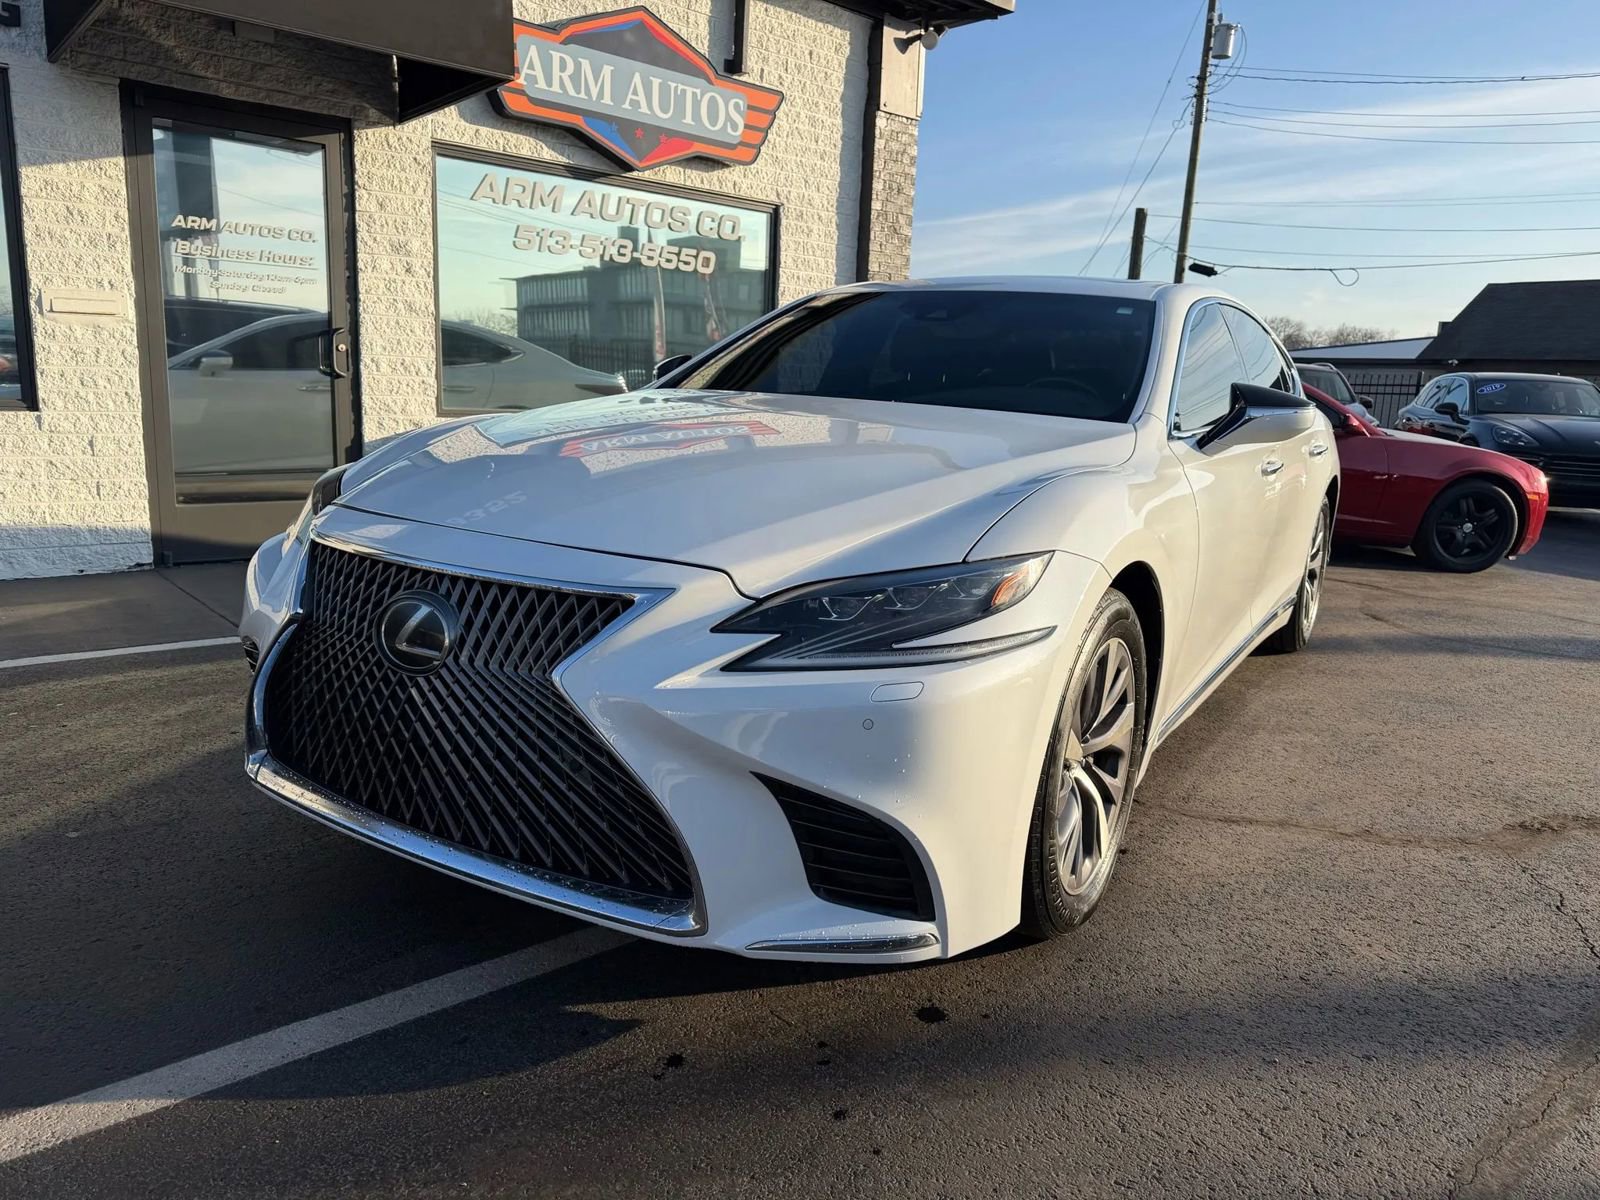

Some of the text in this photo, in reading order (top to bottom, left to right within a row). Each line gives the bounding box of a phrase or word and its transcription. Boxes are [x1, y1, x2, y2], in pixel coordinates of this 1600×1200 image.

[519, 44, 745, 137] ARM AUTOS
[171, 214, 317, 244] ARM AUTOS CO.
[470, 172, 746, 242] ARM AUTOS CO.
[175, 240, 256, 259] Business
[513, 225, 716, 272] 513-513-5550
